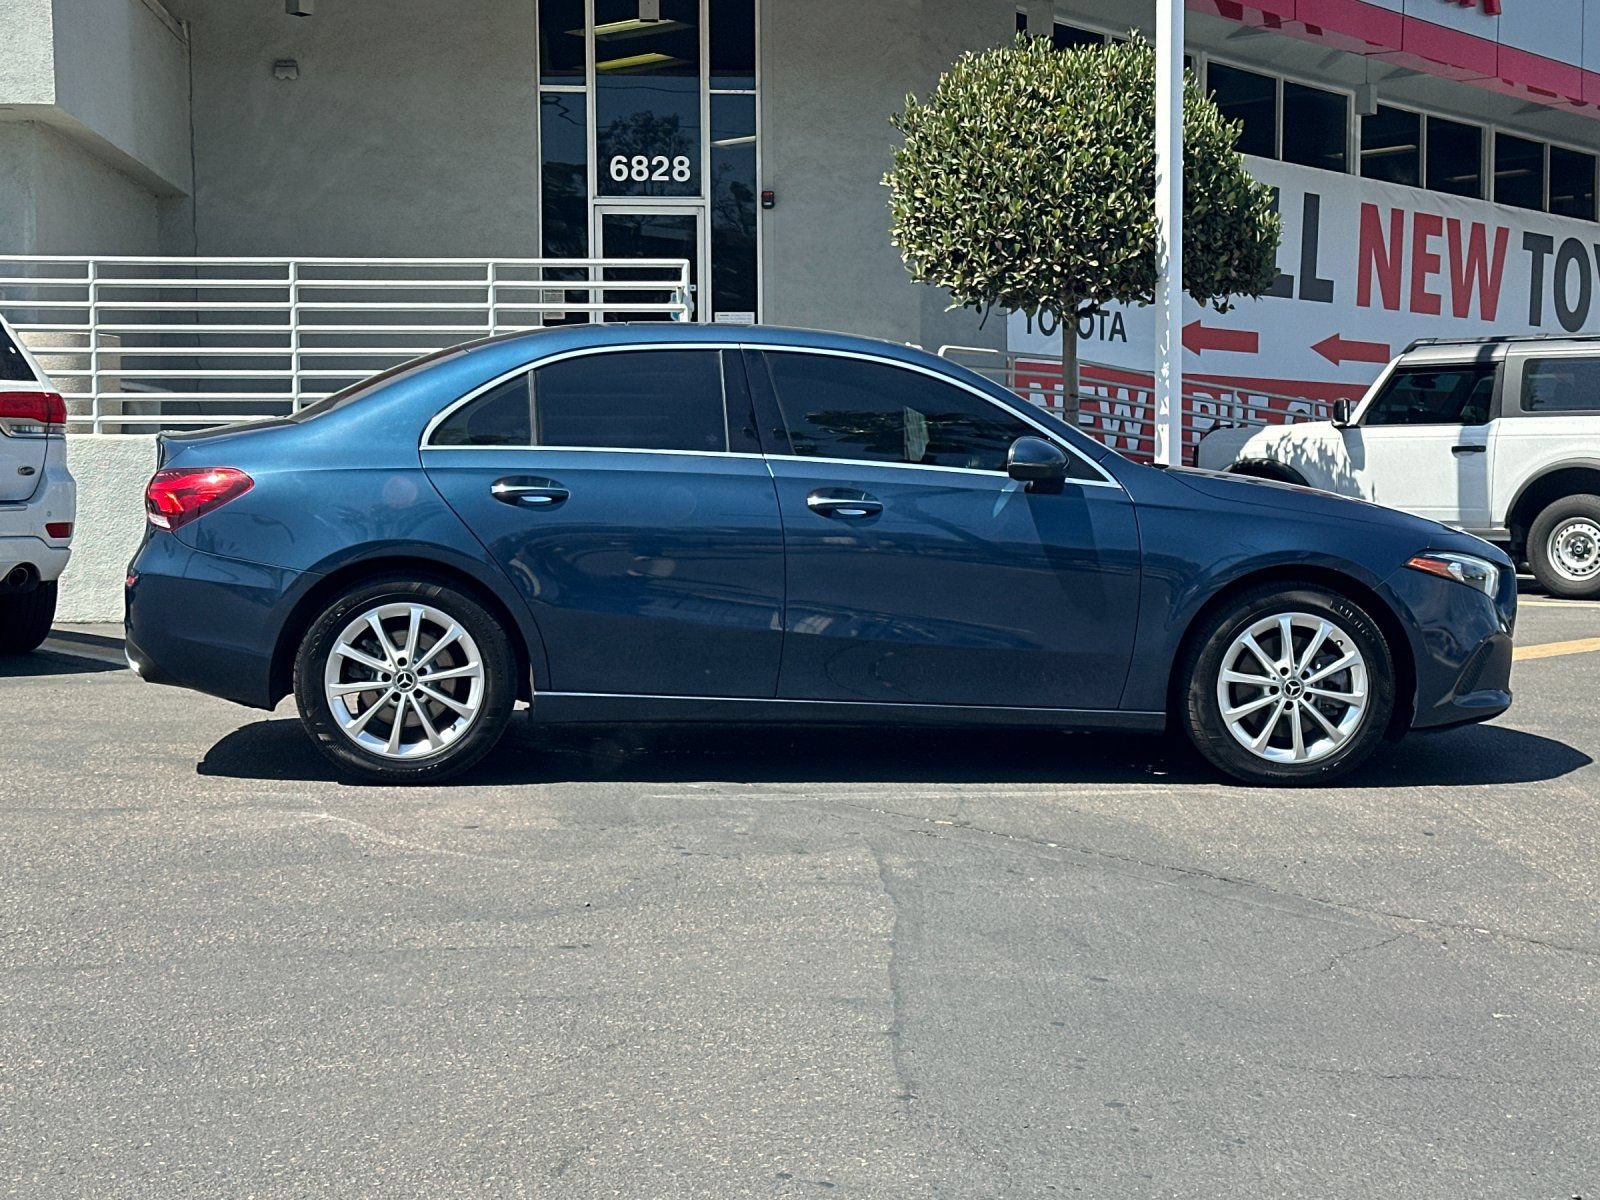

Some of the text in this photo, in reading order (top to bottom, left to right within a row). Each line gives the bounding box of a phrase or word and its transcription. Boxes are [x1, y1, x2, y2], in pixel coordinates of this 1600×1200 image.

[610, 155, 691, 182] 6828
[1259, 186, 1600, 333] LL NEW TO
[1023, 304, 1128, 343] OOTA
